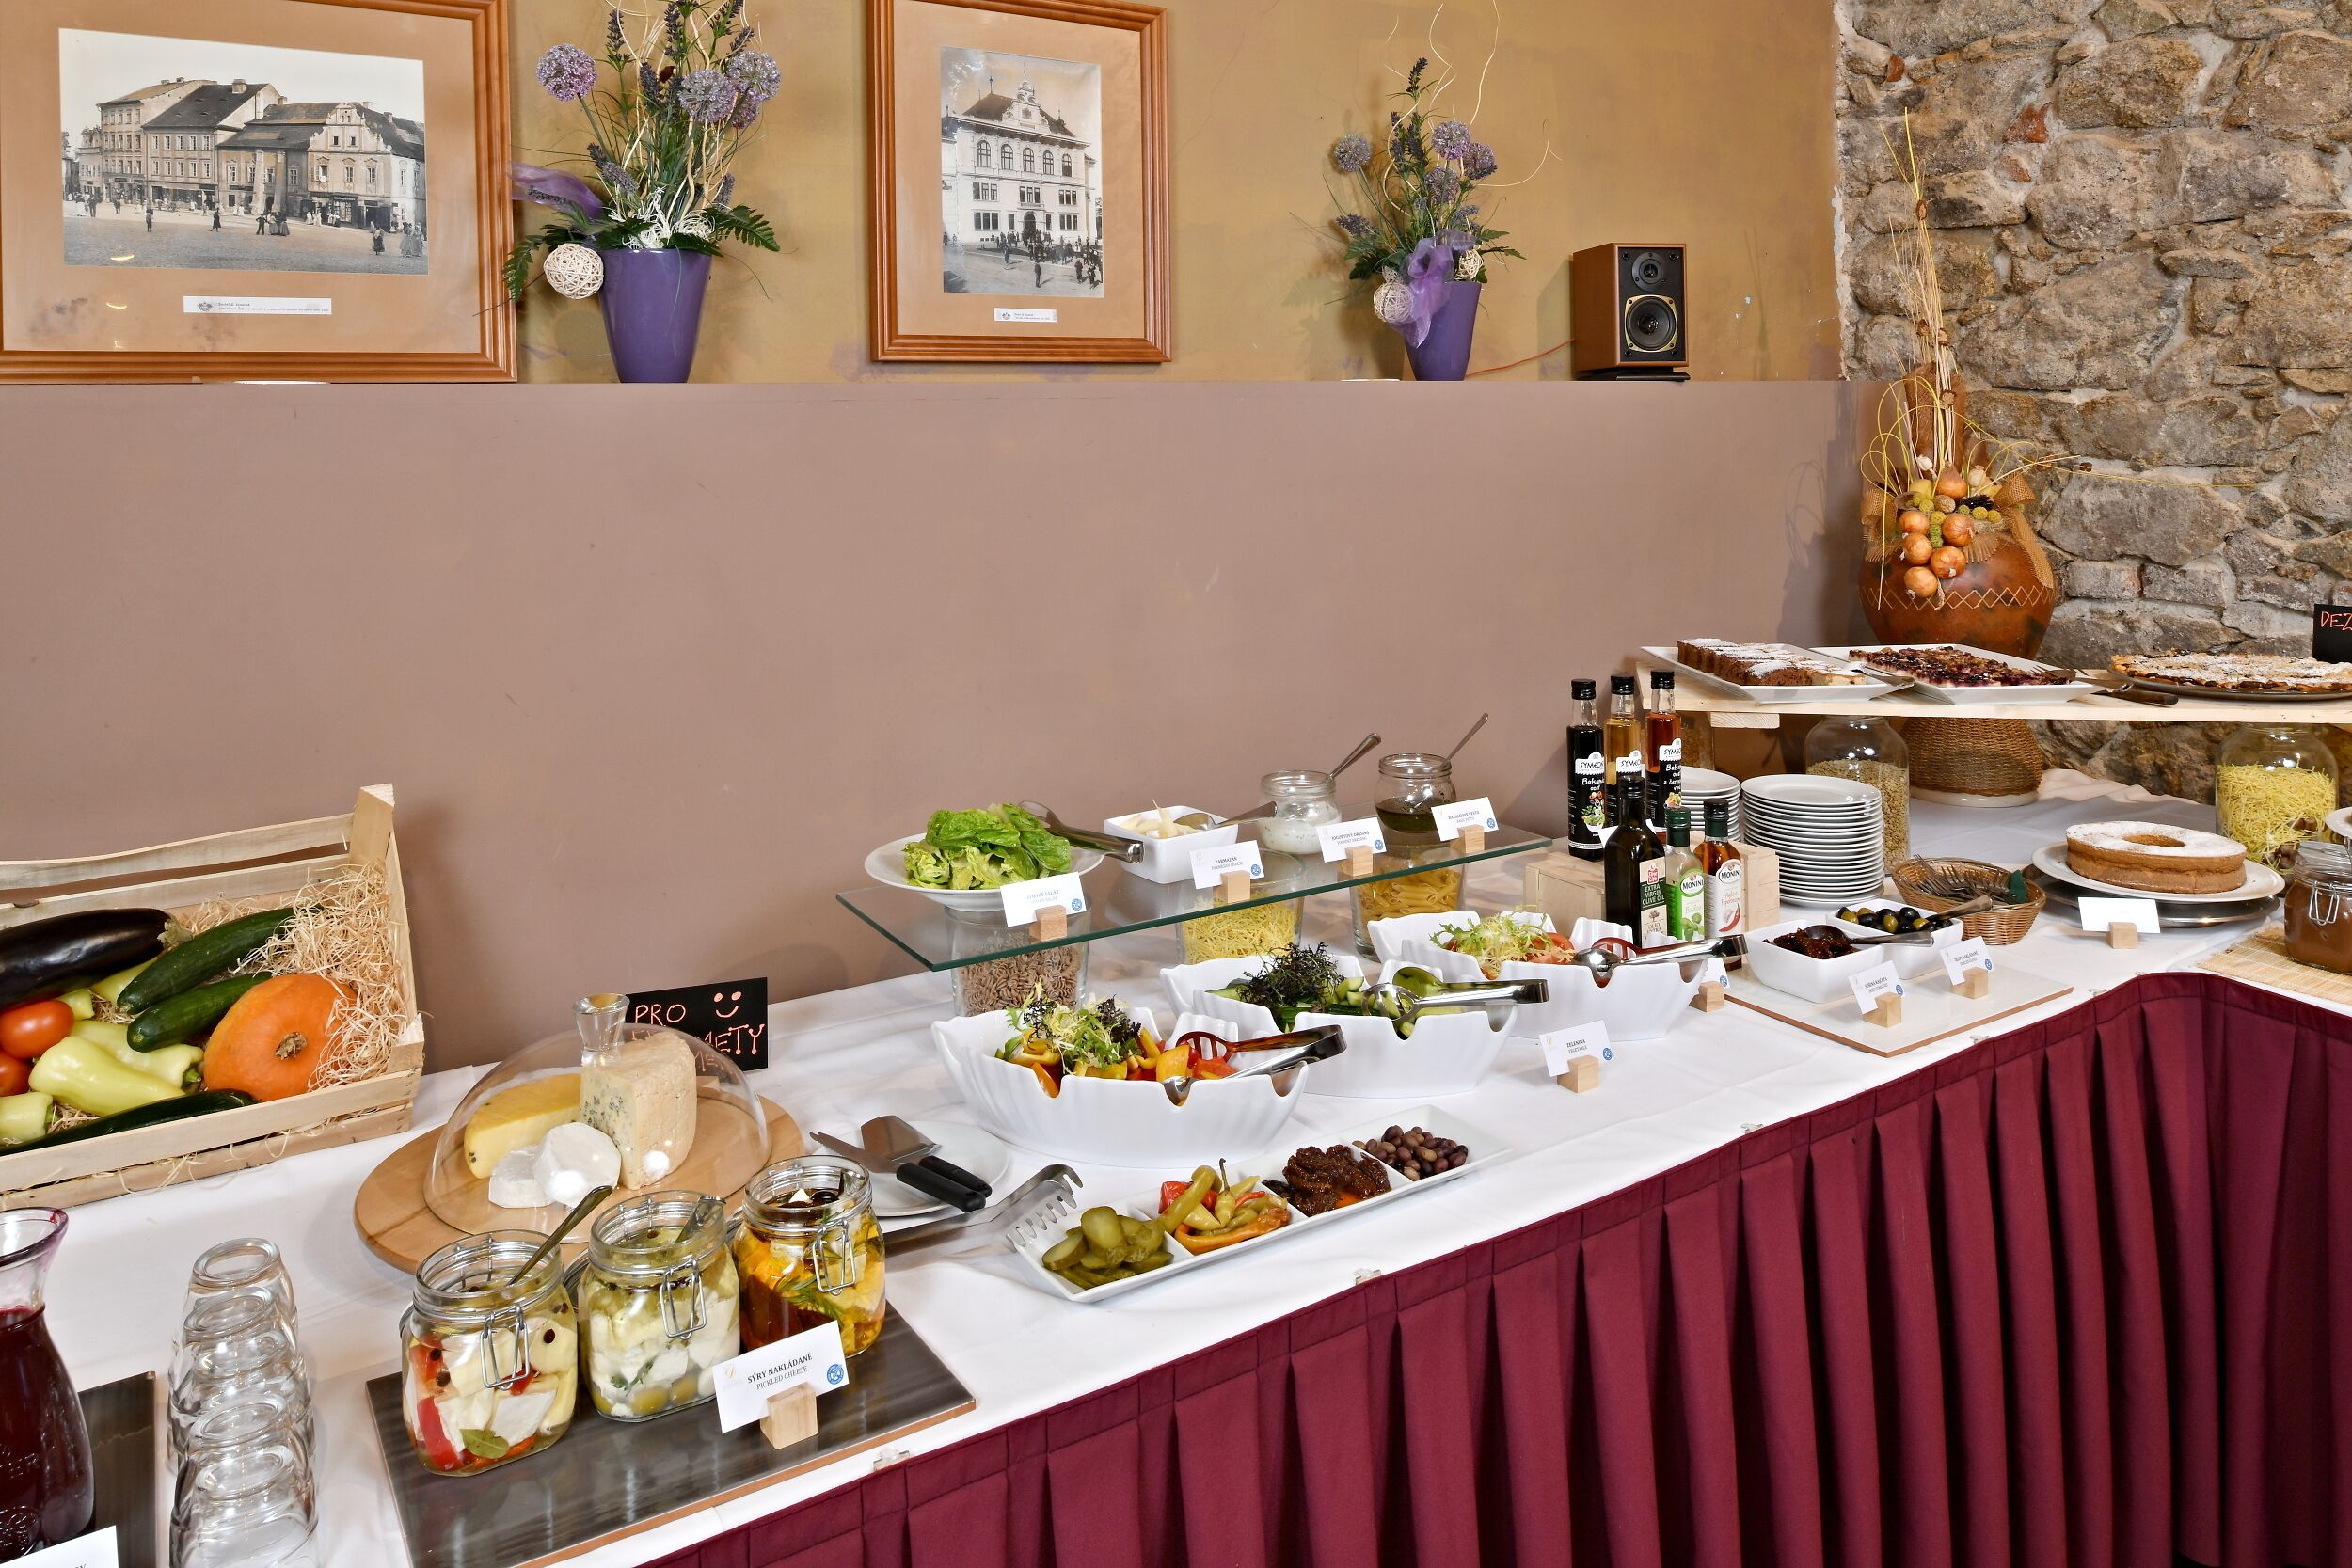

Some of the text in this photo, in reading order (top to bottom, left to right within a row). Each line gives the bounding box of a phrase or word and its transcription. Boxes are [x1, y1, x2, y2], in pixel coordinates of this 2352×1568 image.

[2321, 611, 2352, 630] DEZ
[1721, 869, 1741, 879] MONINI
[1645, 883, 1661, 893] EXTRA
[1682, 879, 1704, 890] MONINI
[1645, 889, 1662, 898] VIRGIN
[1642, 894, 1665, 906] OLIVE OIL
[635, 1004, 687, 1026] PRO
[747, 1370, 767, 1384] SÝRY
[768, 1352, 813, 1375] NAKLÁDANÉ
[756, 1375, 784, 1390] PICKLED
[784, 1365, 808, 1380] CHEESE
